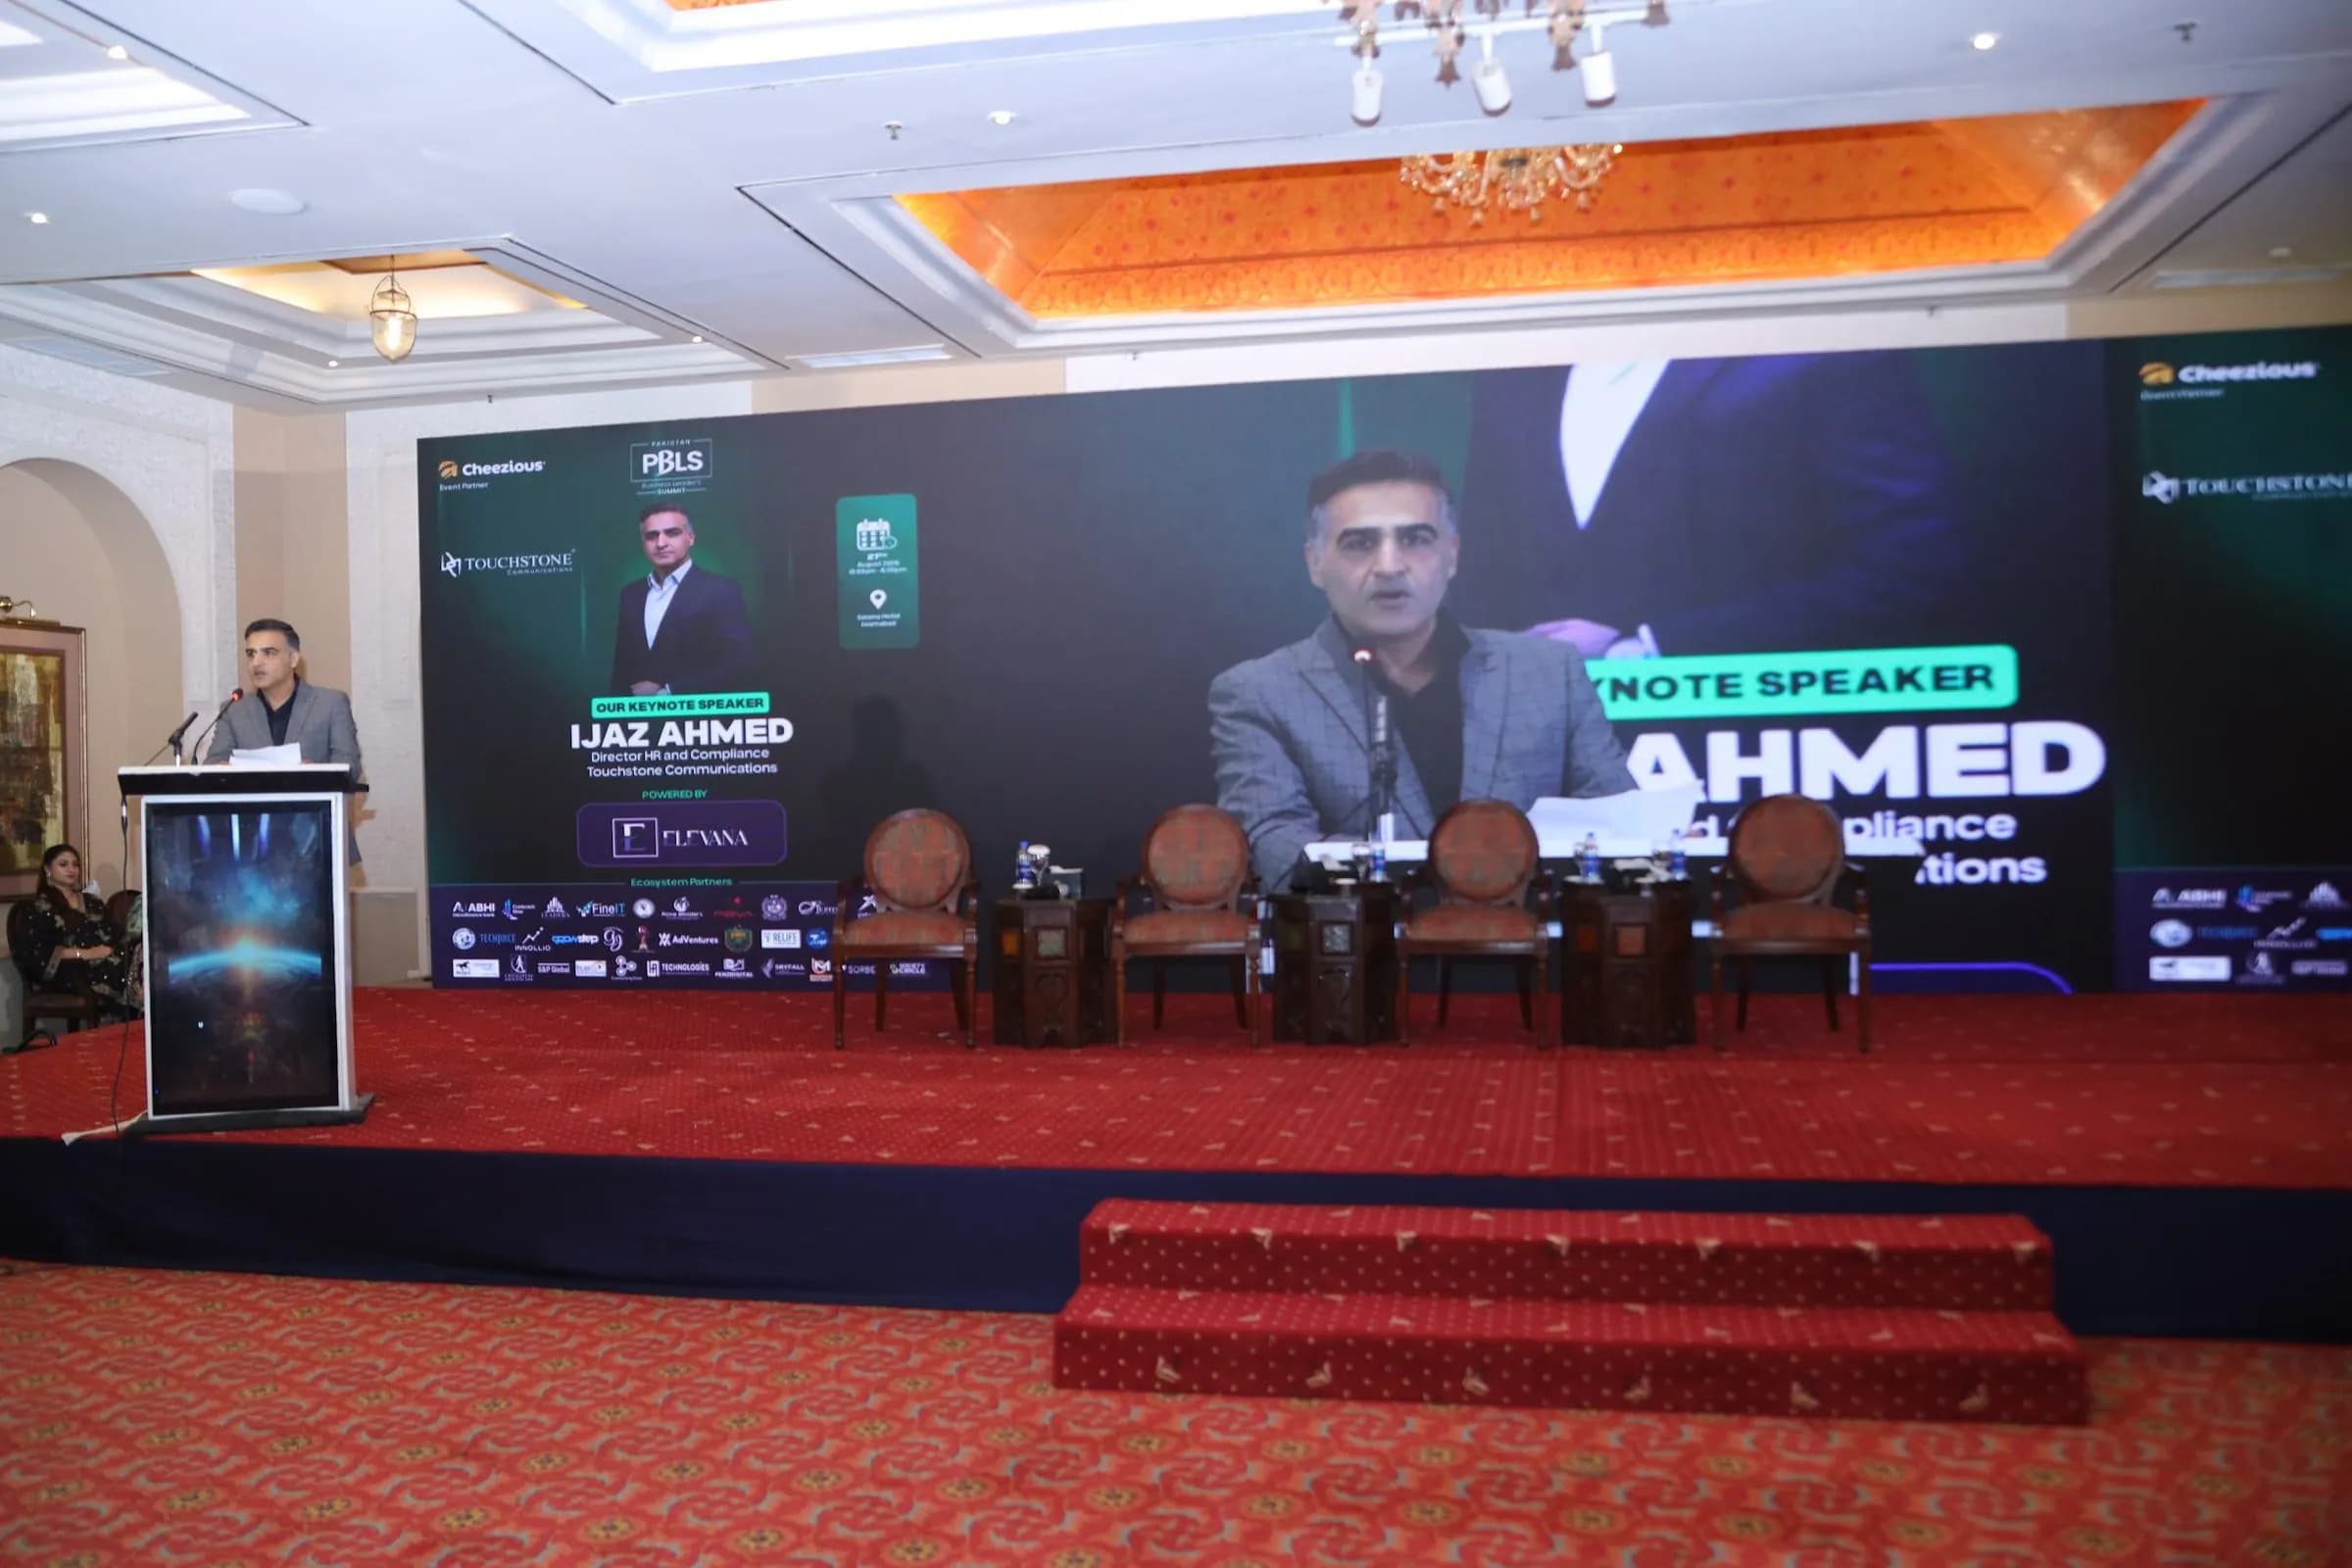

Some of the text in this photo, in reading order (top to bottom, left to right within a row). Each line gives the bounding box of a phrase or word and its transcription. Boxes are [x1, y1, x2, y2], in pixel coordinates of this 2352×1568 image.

[2179, 362, 2317, 382] Cheezious
[463, 460, 544, 476] Cheezious
[643, 450, 703, 475] PBLS
[465, 554, 572, 570] TOUCHSTONE
[1756, 663, 1994, 697] SPEAKER
[596, 697, 764, 713] OUR KEYNOTE SPEAKER
[570, 718, 794, 749] IJAZ AHMED
[591, 748, 769, 762] Director HR and Compliance
[1626, 720, 2106, 803] AHMED
[587, 763, 778, 777] Touchstone Communications
[642, 789, 708, 800] POWERED BY
[662, 829, 749, 847] ELEVANA
[630, 877, 733, 888] Ecosystem Partners
[467, 903, 495, 912] ABHI
[592, 903, 625, 914] FineIT
[672, 934, 718, 945] AdVentures
[662, 962, 710, 972] TECHNOLOGIES
